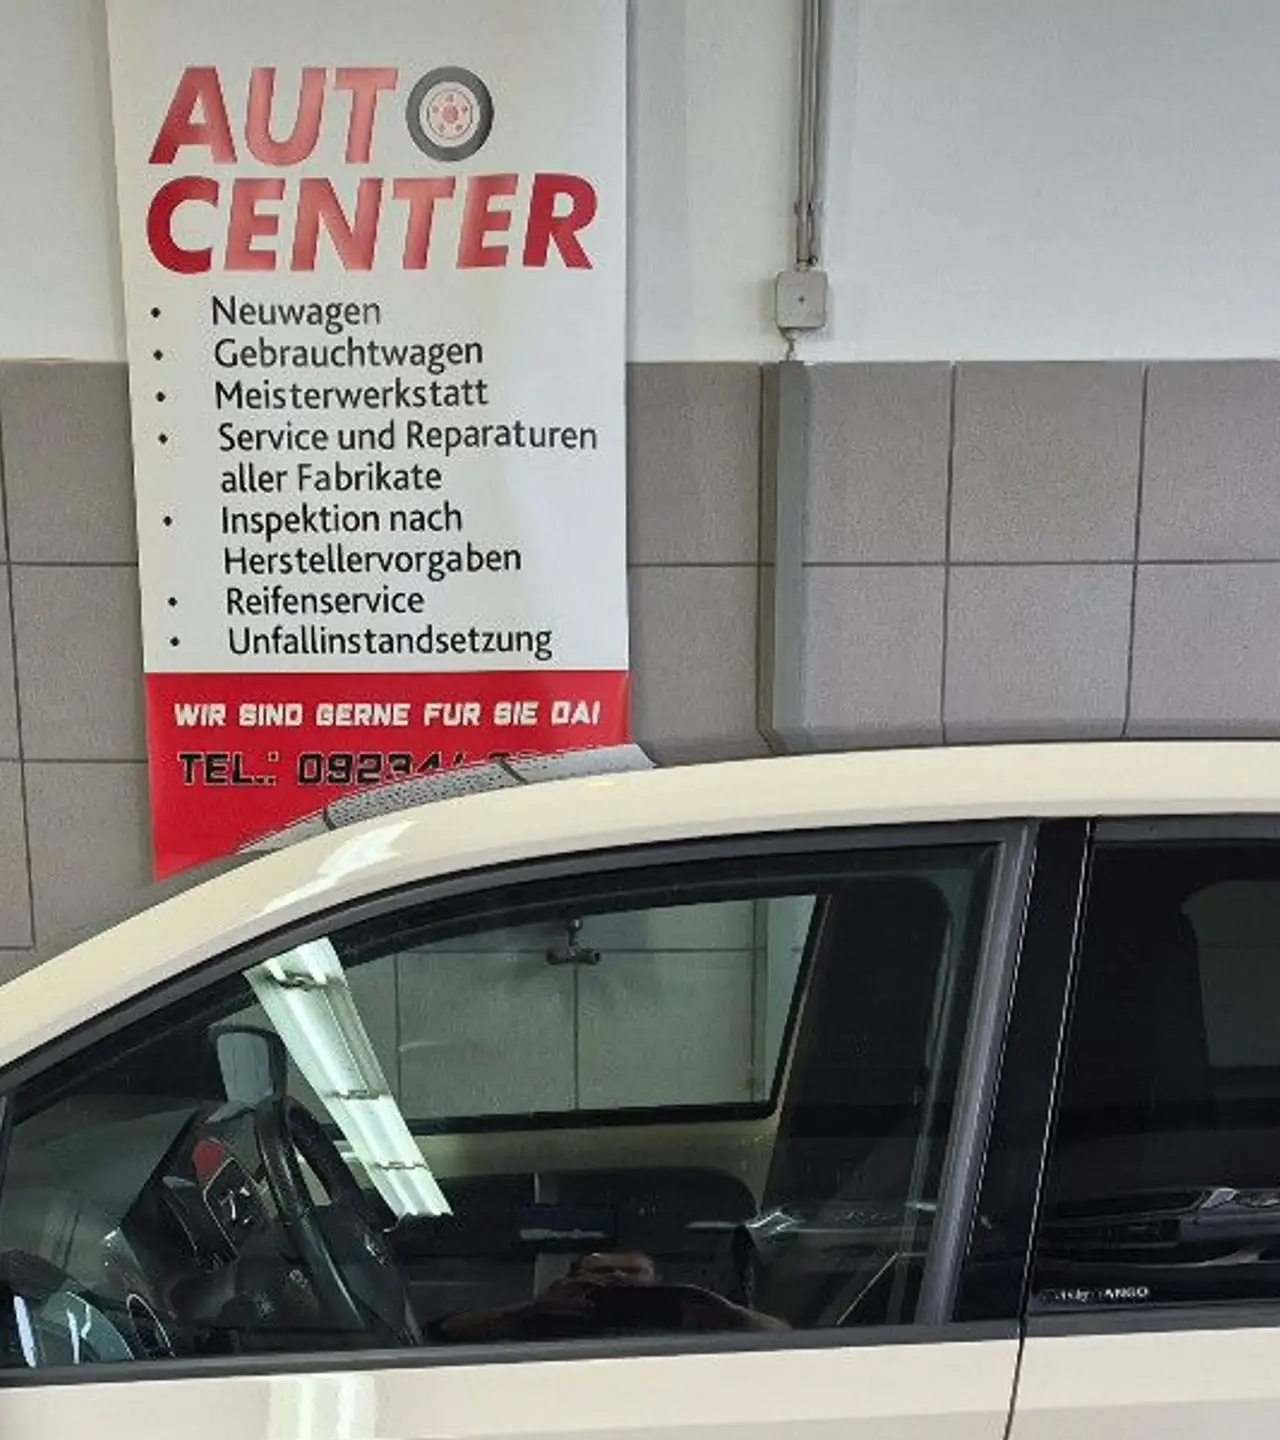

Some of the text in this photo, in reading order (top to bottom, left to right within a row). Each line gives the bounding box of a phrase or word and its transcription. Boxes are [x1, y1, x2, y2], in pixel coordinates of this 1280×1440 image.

[146, 173, 598, 275] CENTER
[211, 296, 381, 334] Neuwagen
[214, 339, 483, 375] Gebrauchtwagen
[215, 378, 489, 410] Meisterwerkstatt
[218, 419, 598, 456] Service und Reparaturen
[220, 461, 442, 493] aller Fabrikate
[221, 501, 463, 542] Inspektion nach
[224, 543, 522, 581] Herstellervorgaben
[226, 585, 425, 615] Reifenservice
[228, 624, 553, 661] Unfallinstandsetzung
[174, 703, 227, 727] WIR
[239, 703, 303, 727] SIND
[316, 703, 411, 727] GERNE
[493, 701, 539, 726] SIE
